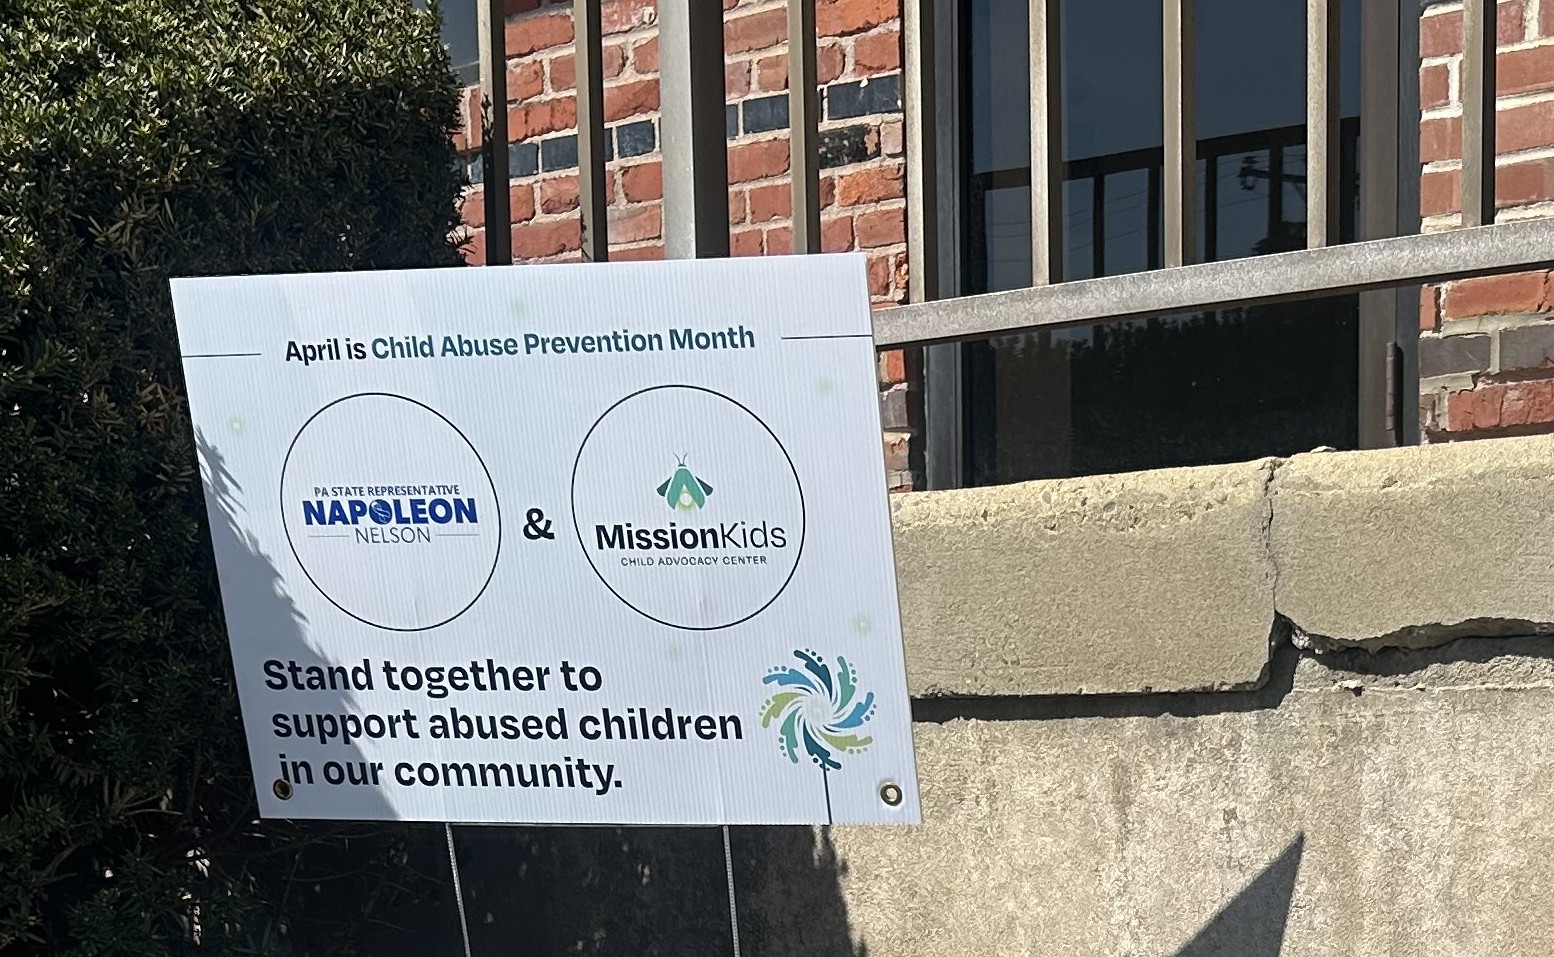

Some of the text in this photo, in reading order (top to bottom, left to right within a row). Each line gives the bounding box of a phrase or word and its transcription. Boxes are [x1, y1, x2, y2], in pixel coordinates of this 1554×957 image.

[285, 325, 756, 366] April is Child Abuse Prevention Month
[314, 484, 461, 497] PA STATE REPRESENTATIVE
[302, 498, 479, 526] NAPOLEON
[523, 508, 555, 541] &
[355, 526, 432, 544] NELSON
[595, 520, 787, 550] MissionKids
[620, 555, 768, 567] CHILD ADVOCACY CENTER
[263, 658, 603, 699] Stand together to
[272, 707, 743, 745] support abused children
[278, 753, 623, 796] in our community.
